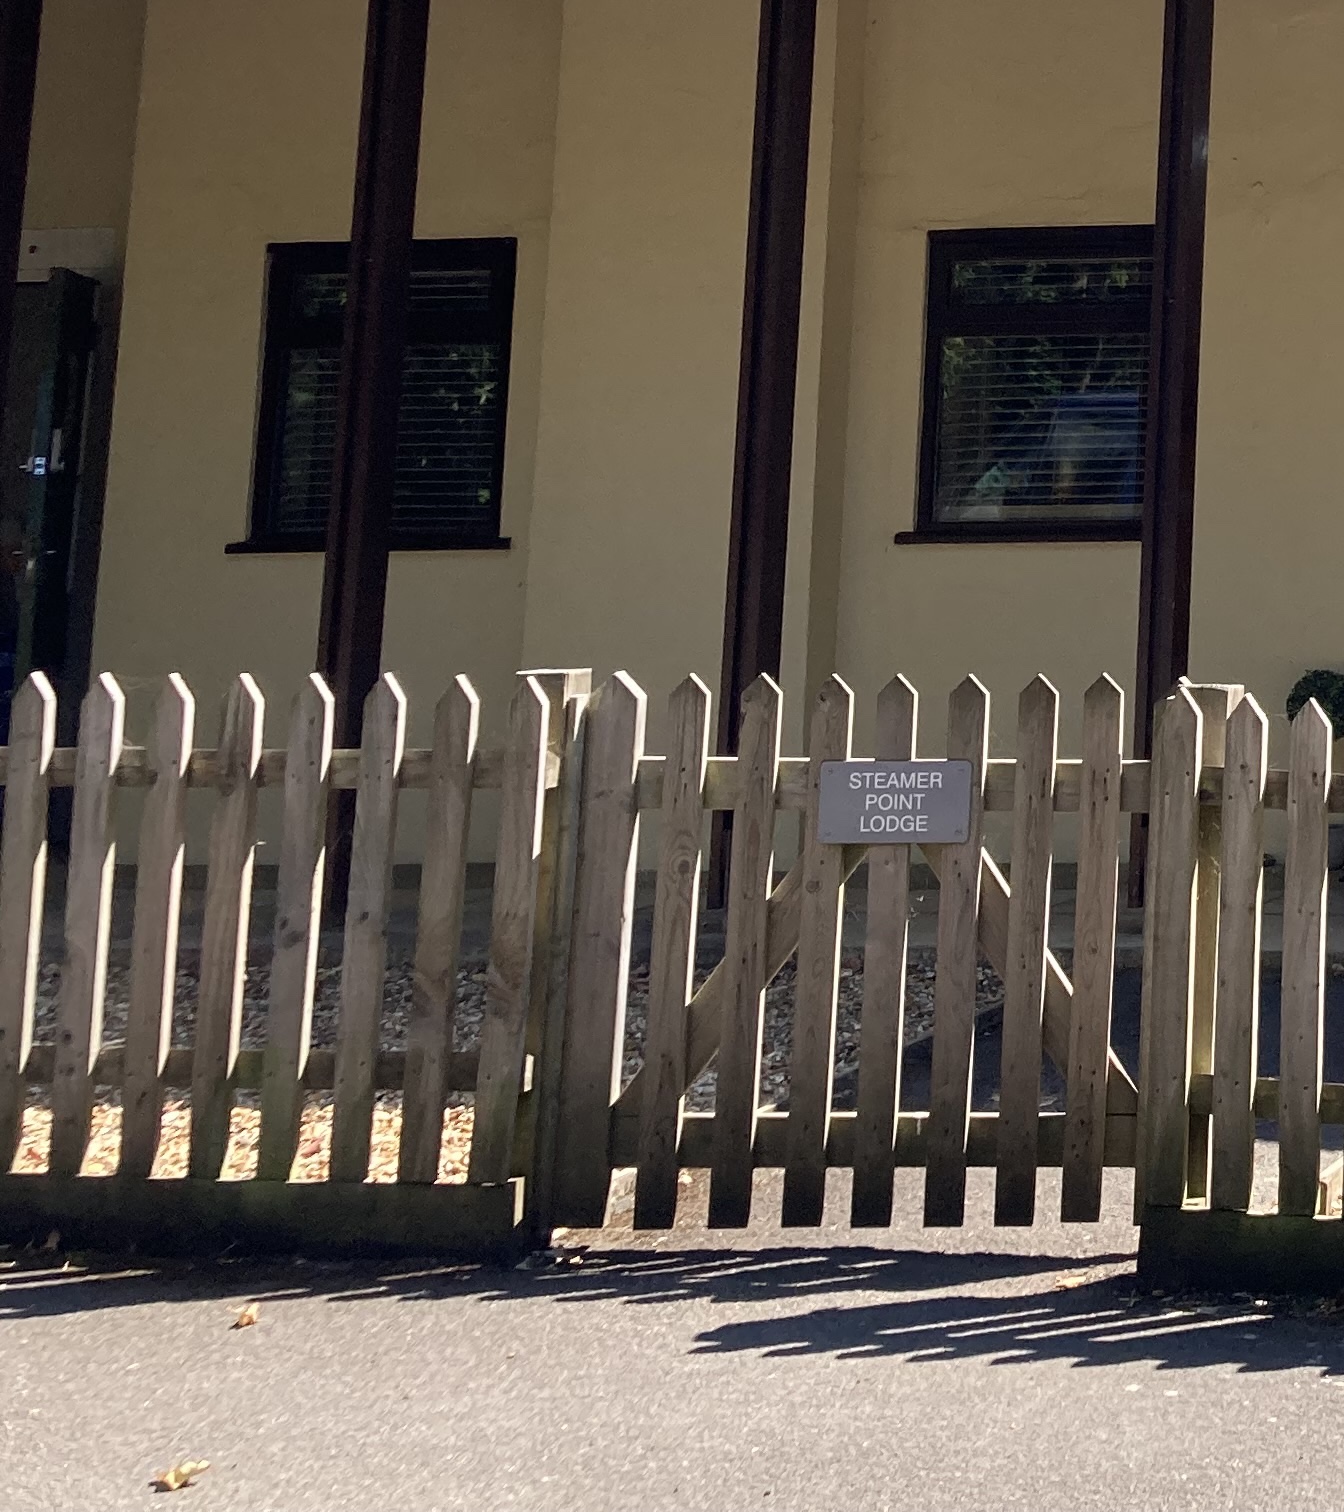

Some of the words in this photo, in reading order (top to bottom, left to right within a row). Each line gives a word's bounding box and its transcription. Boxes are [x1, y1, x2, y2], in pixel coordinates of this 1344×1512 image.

[849, 772, 943, 790] STEAMER
[865, 793, 926, 811] POINT
[860, 815, 929, 833] LODGE
